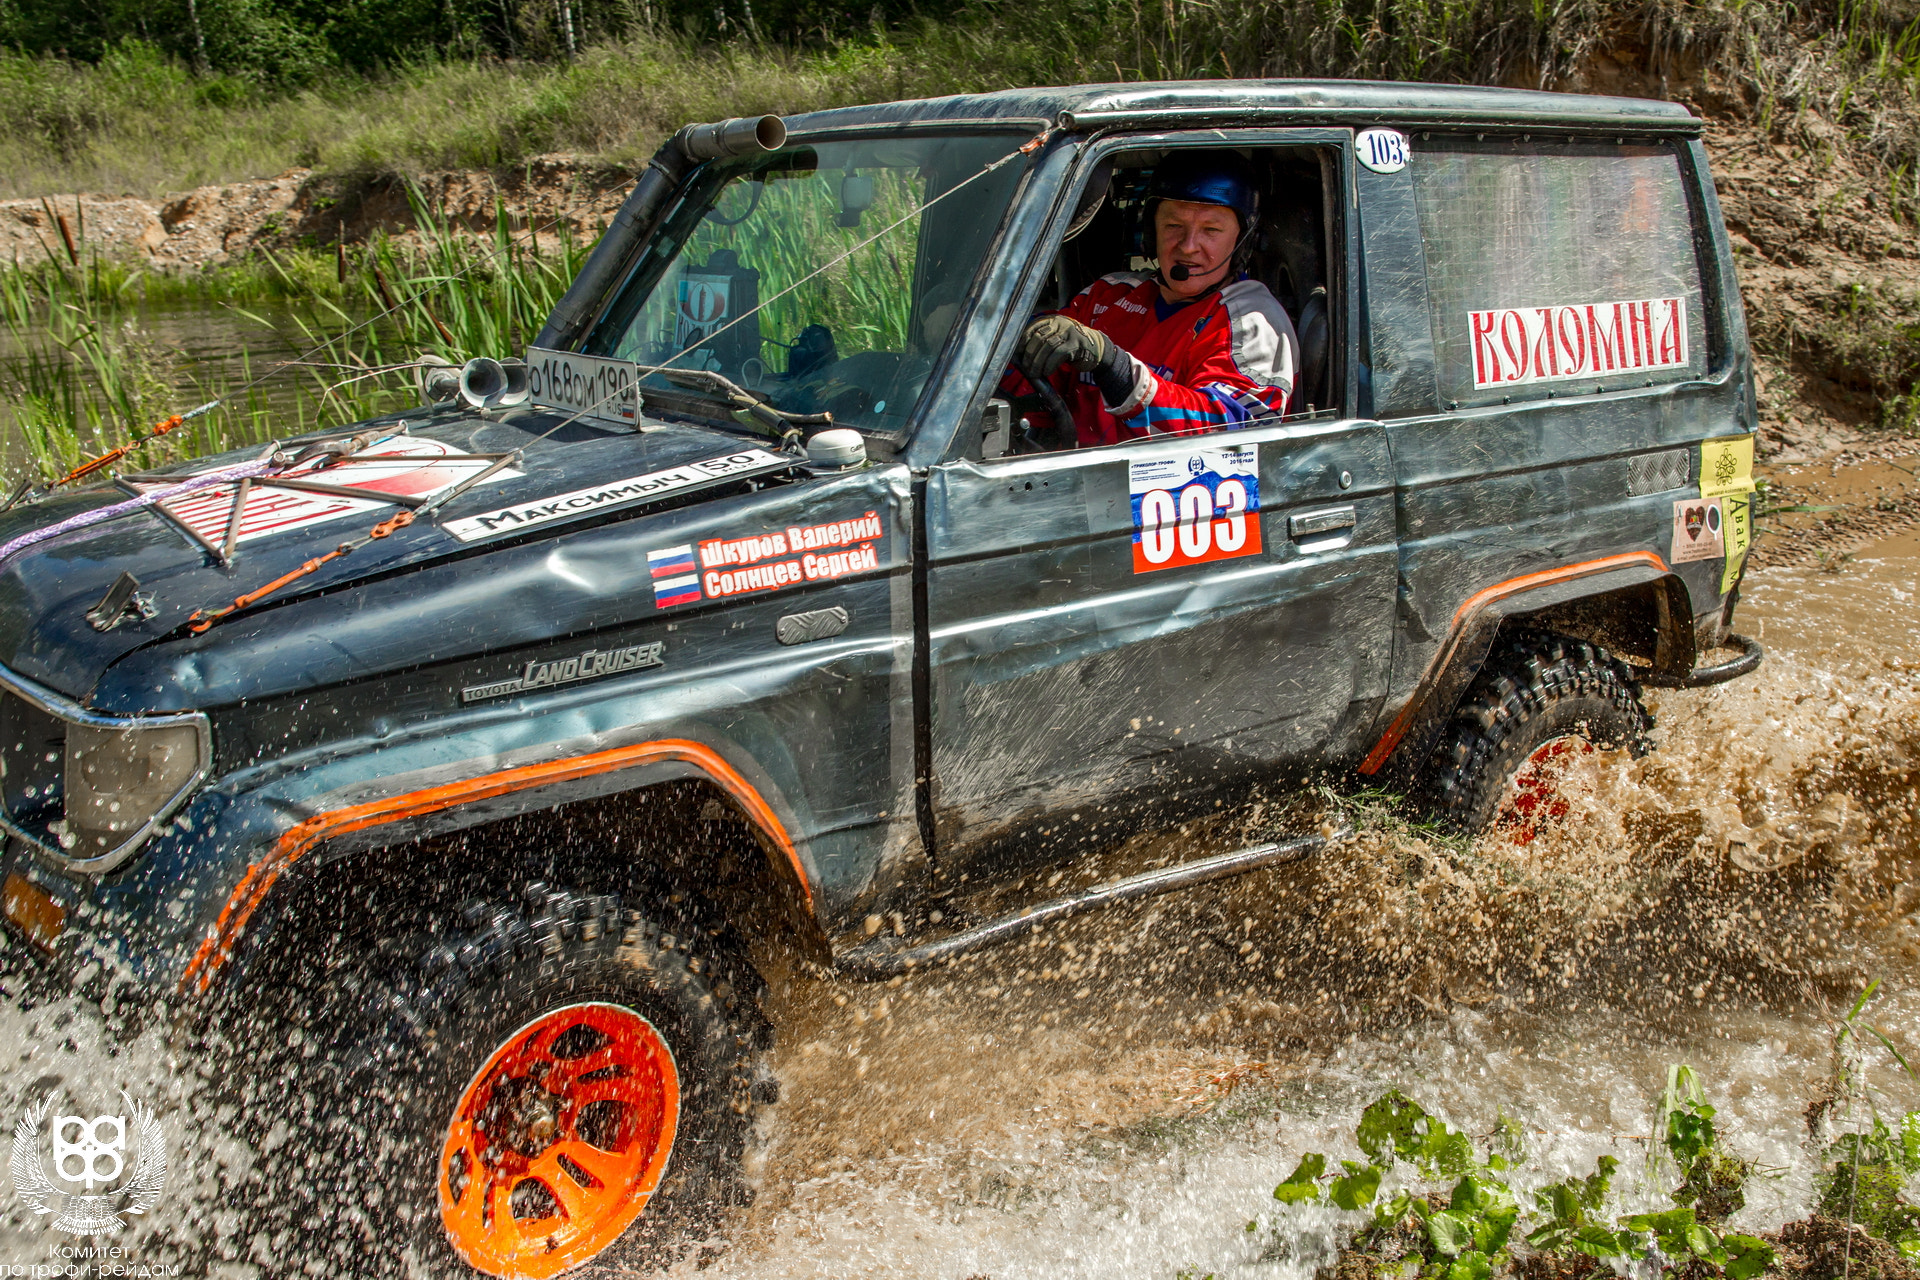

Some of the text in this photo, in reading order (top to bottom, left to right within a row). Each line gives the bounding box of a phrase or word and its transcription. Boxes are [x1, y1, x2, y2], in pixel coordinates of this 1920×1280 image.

[1367, 133, 1403, 165] 103
[1470, 299, 1685, 385] КОЛОМНА
[598, 365, 629, 402] 190
[606, 402, 622, 416] RUS
[700, 455, 755, 470] 50
[700, 512, 882, 567] Шкуров Валерий
[1140, 478, 1248, 564] 003
[704, 544, 878, 597] Солнцев Сергей
[465, 683, 520, 699] TOYOTA
